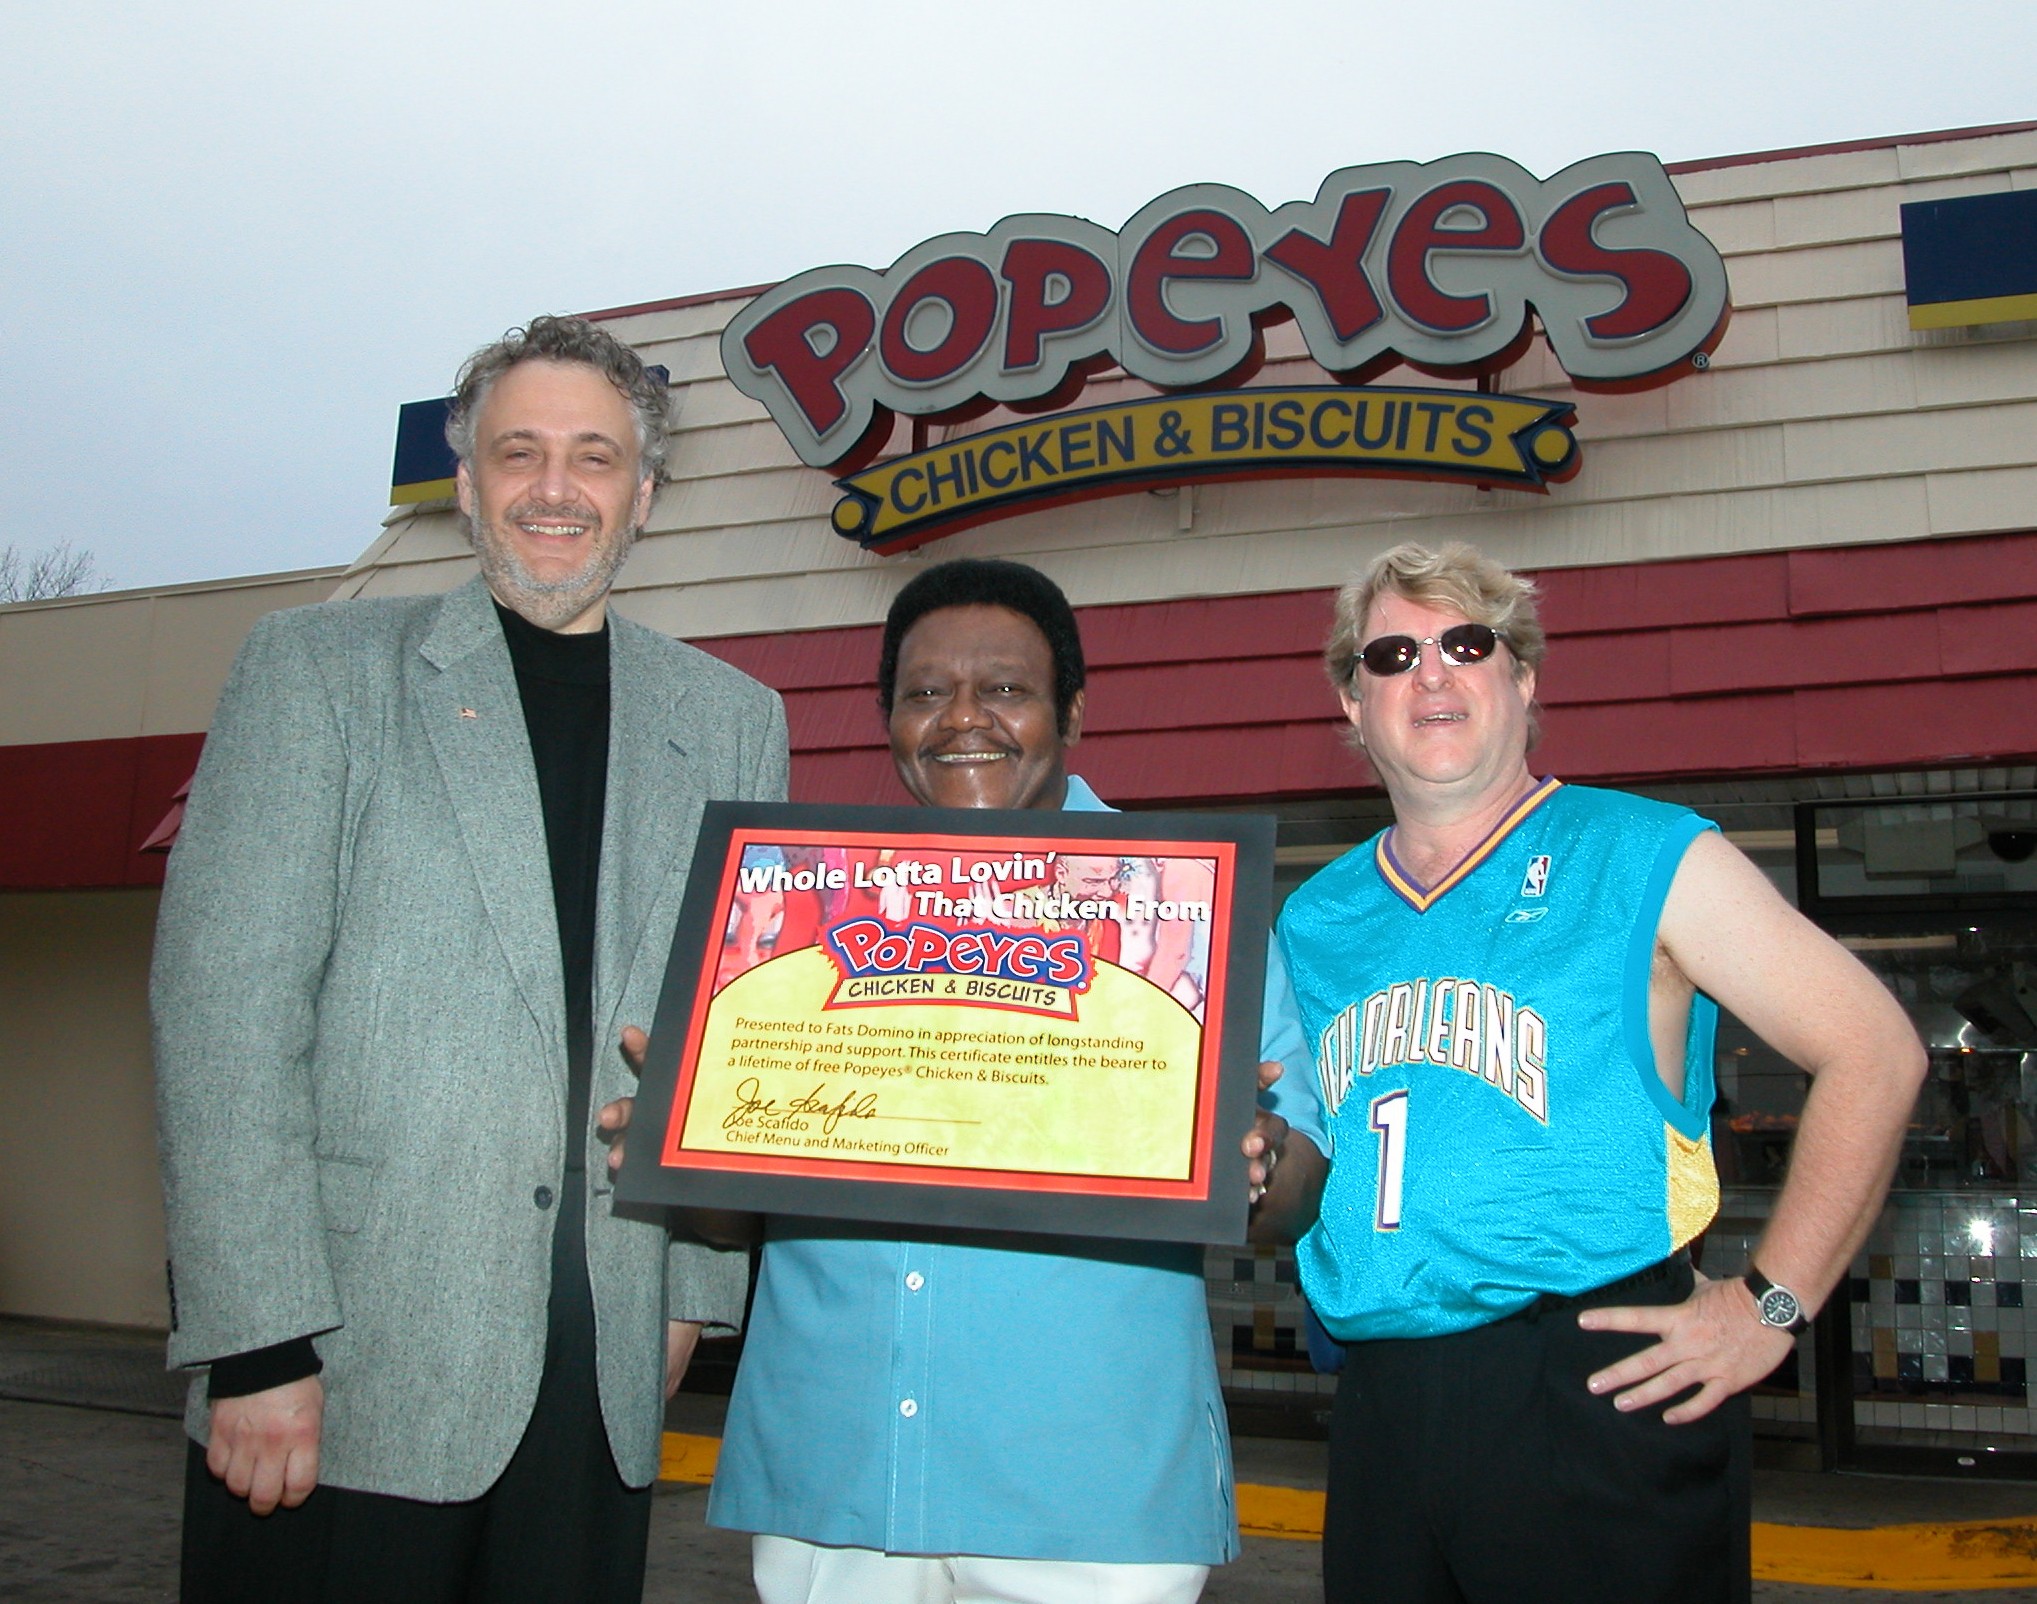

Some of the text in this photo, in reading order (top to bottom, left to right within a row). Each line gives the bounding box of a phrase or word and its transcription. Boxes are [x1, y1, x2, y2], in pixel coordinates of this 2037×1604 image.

[890, 399, 1495, 514] CHICKEN & BISCUITS
[739, 862, 847, 894] Whole
[853, 860, 943, 888] Lotta
[915, 890, 1210, 922] That Chicken From
[848, 978, 1056, 1006] CHICKEN & BISCUITS
[736, 1017, 1144, 1052] Presented to Fats Domino in appreciation of longstanding
[731, 1038, 1167, 1070] partnership and support. This certificate entitles the bearer to
[1359, 976, 1550, 1127] ORLEANS
[727, 1057, 736, 1067] a
[739, 1055, 791, 1070] lifetime
[795, 1058, 811, 1071] of
[813, 1059, 840, 1073] free
[915, 1065, 973, 1081] Chicken
[977, 1070, 987, 1082] &
[991, 1072, 1050, 1085] Biscuits.
[722, 1077, 781, 1129] Joe
[757, 1116, 809, 1131] Scafido
[726, 1130, 949, 1156] Chief Menu and Marketing Officer
[1368, 1089, 1410, 1232] 1
